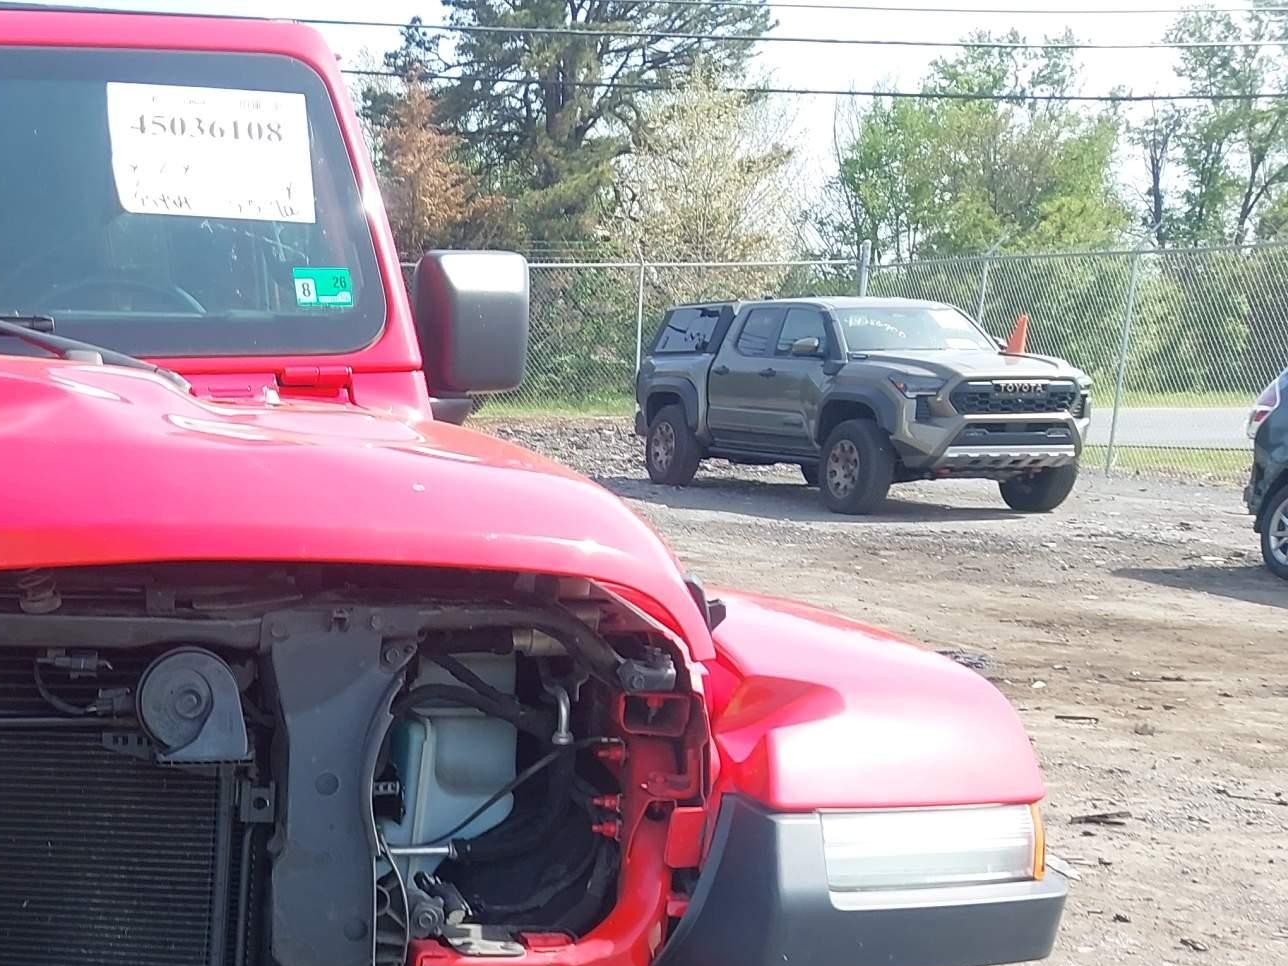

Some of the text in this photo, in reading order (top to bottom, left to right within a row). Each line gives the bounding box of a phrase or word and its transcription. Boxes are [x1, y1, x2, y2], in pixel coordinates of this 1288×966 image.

[130, 114, 283, 142] 45036108
[302, 282, 311, 298] 8
[1000, 383, 1044, 392] TOYOTA
